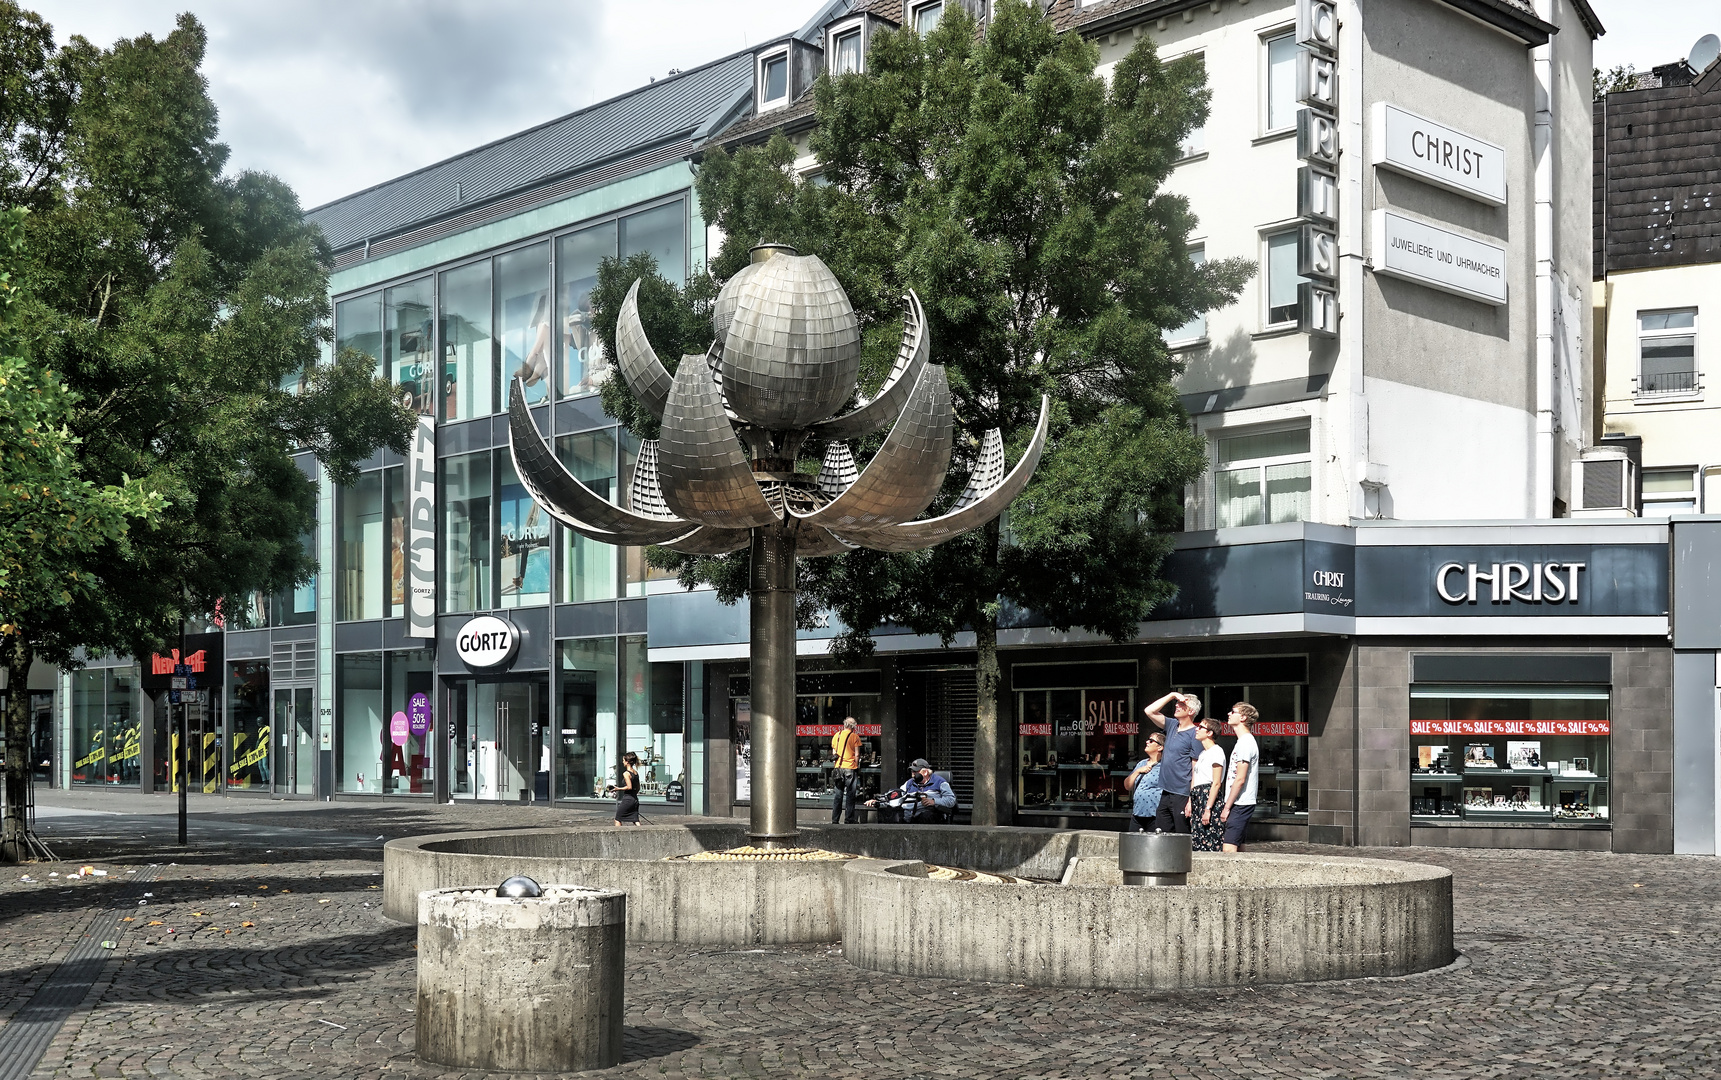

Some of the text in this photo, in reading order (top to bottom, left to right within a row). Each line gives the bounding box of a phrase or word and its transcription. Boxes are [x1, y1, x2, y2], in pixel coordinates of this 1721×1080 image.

[1412, 130, 1483, 179] CHRIST
[1391, 236, 1500, 279] JUWELIERE UND UHRMACHER
[1313, 570, 1344, 587] CHRIST
[1436, 562, 1586, 602] CHRIST
[1305, 592, 1330, 601] TRAURING
[412, 698, 425, 707] SALE
[412, 713, 426, 724] 50%
[871, 726, 881, 735] SALE
[1019, 724, 1031, 735] SALE
[1040, 724, 1052, 735] SALE
[1072, 720, 1094, 732] 60%
[1104, 723, 1117, 734] SALE
[1126, 723, 1139, 734] SALE
[1271, 724, 1286, 734] SALE
[1412, 721, 1431, 733] SALE
[1443, 721, 1462, 733] SALE
[1474, 721, 1493, 733] SALE
[1505, 721, 1524, 733] SALE
[1536, 721, 1556, 733] SALE
[1568, 721, 1587, 733] SALE
